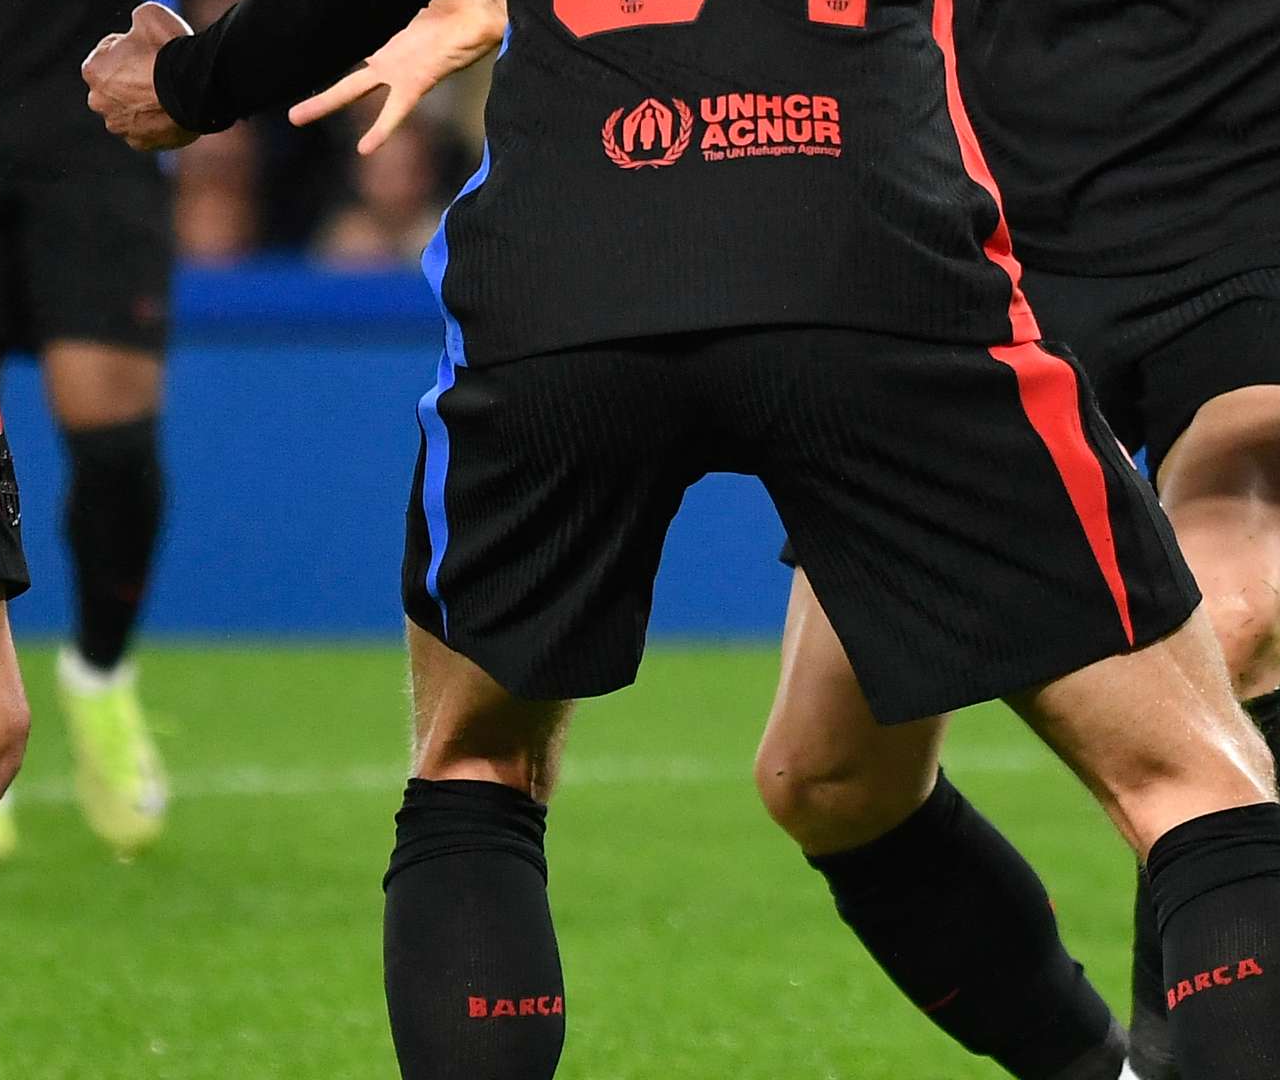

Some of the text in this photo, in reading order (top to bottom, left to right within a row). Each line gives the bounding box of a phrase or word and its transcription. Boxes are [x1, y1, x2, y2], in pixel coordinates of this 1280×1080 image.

[700, 93, 841, 122] UNHCR
[700, 118, 842, 150] ACNUR
[702, 144, 841, 162] The UN Refugee Agency
